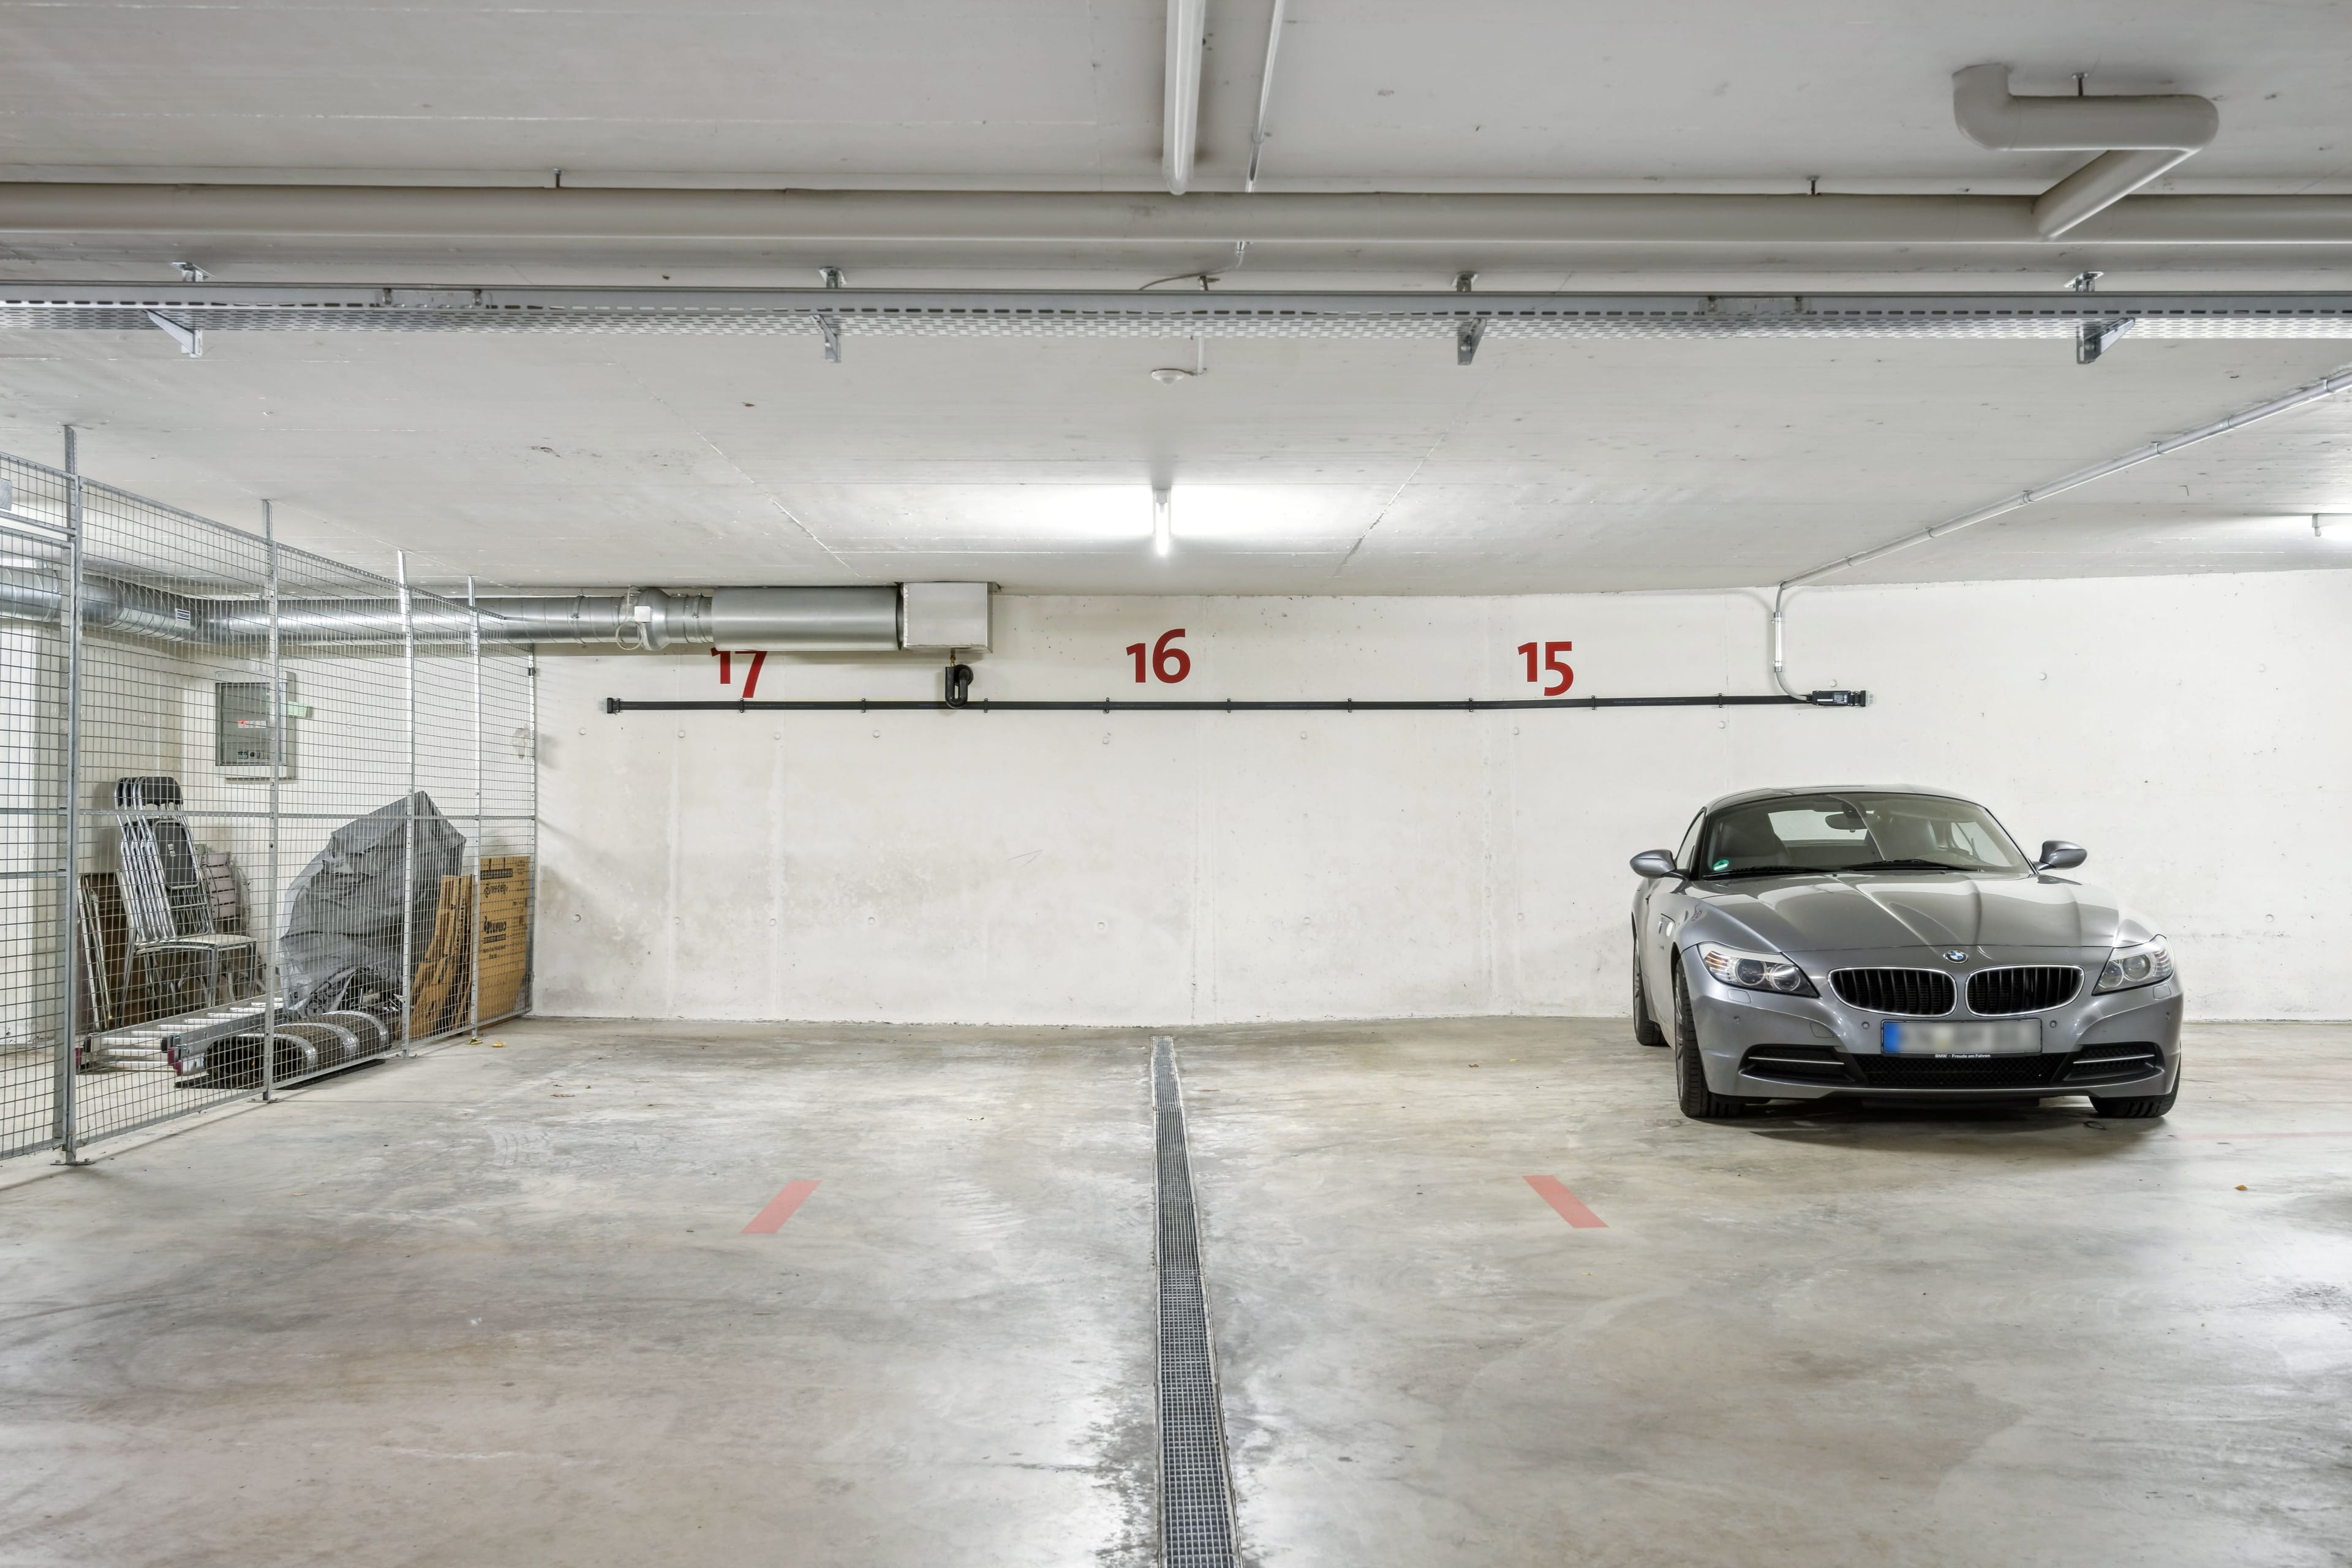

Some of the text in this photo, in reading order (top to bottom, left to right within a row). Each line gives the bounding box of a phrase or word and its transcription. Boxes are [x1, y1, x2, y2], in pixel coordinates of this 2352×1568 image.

[710, 647, 767, 698] 17
[1126, 628, 1190, 683] 16
[1517, 641, 1574, 696] 15
